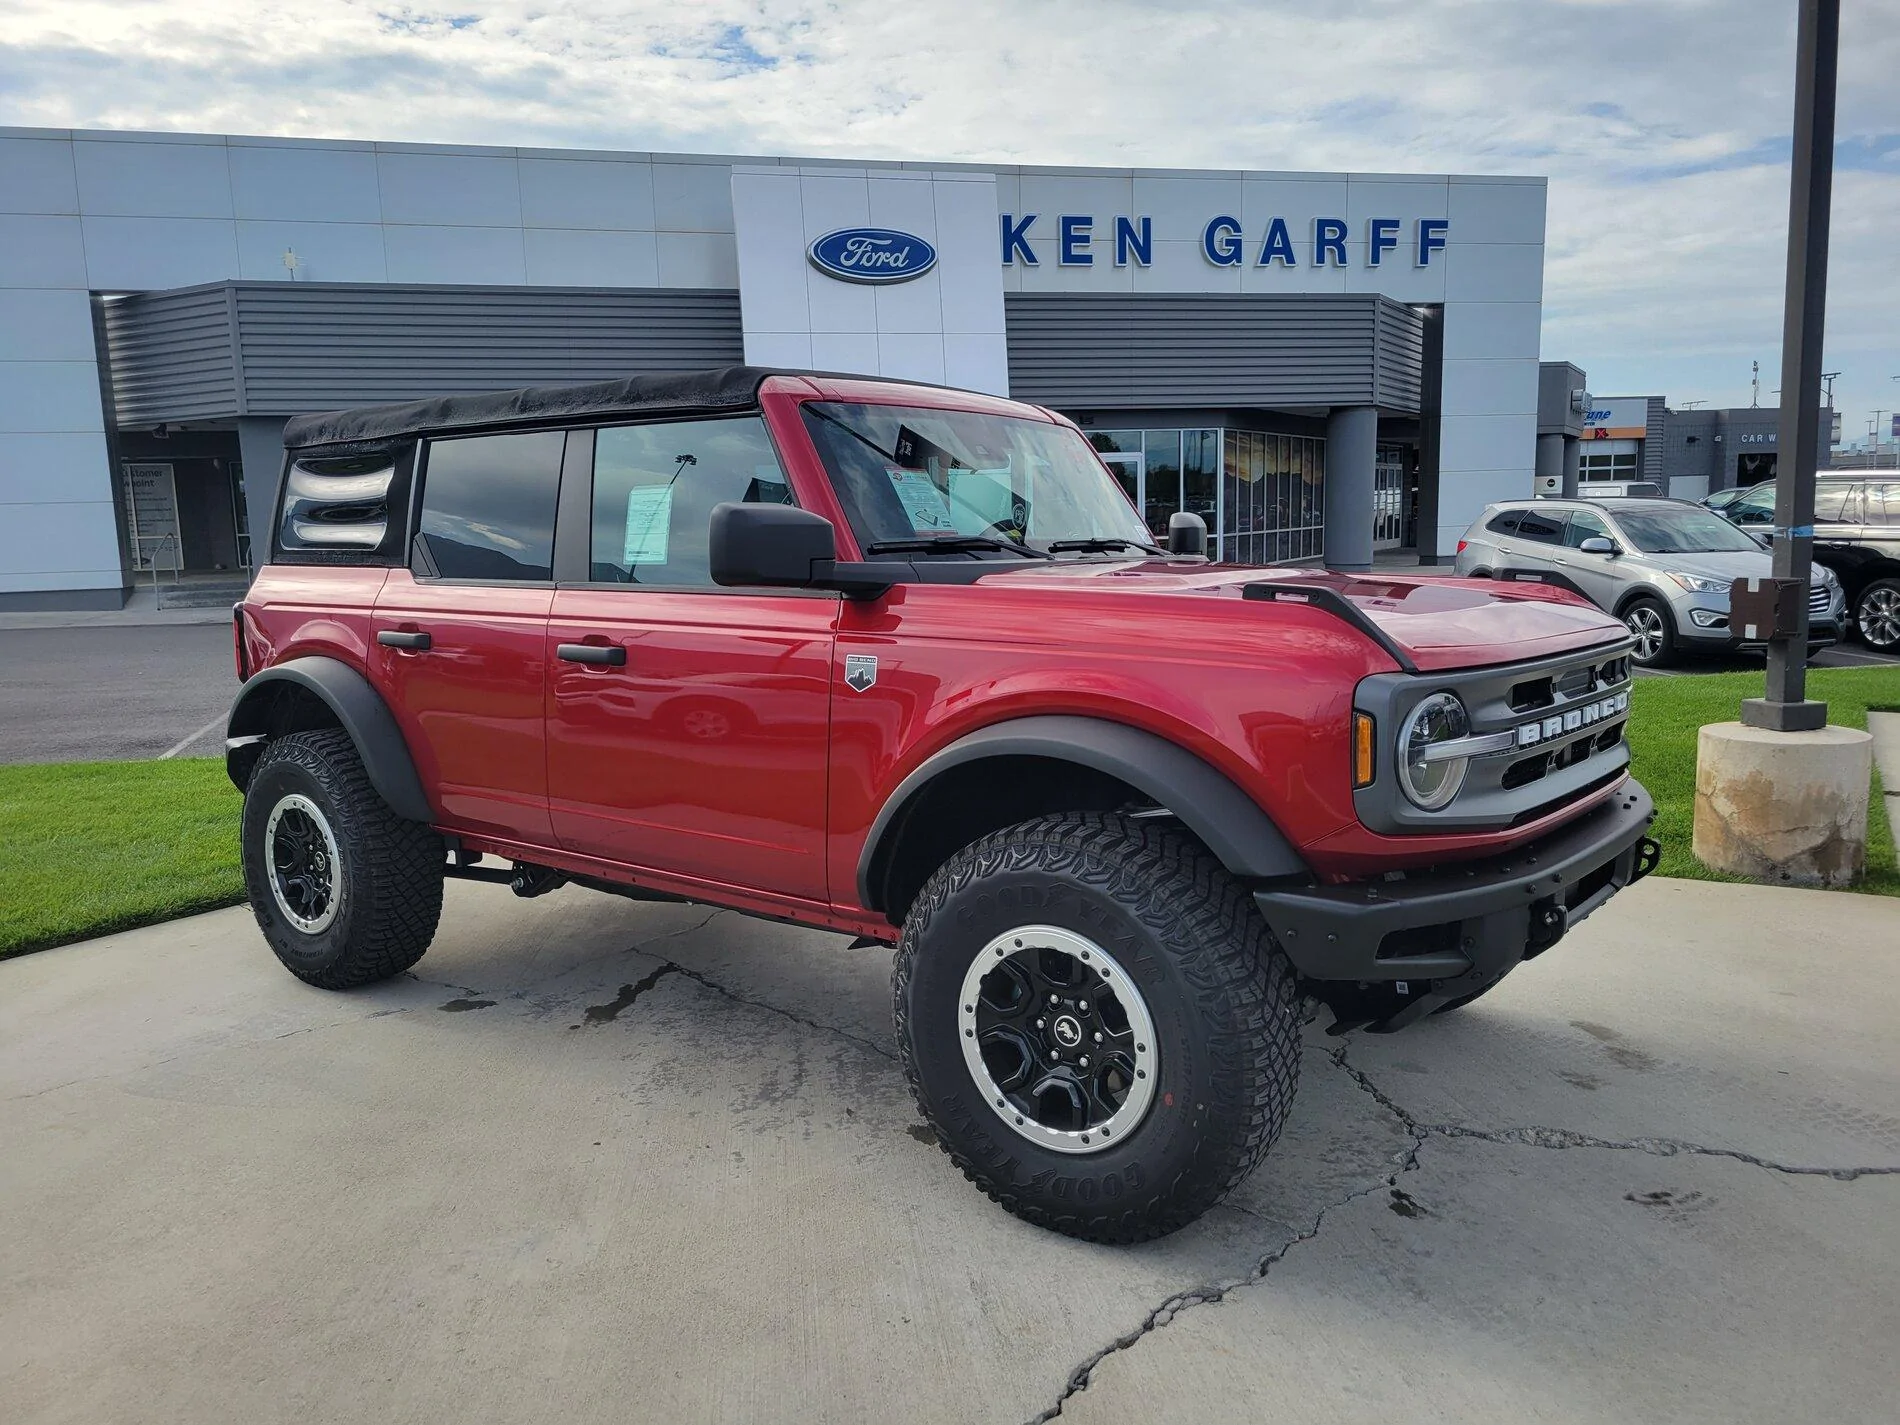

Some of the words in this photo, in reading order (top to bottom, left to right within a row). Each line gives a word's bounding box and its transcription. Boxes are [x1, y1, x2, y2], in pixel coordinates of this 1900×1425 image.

[1000, 213, 1153, 267] KEN
[1202, 214, 1450, 267] GARFF
[840, 237, 910, 268] Ford
[1584, 410, 1611, 421] ane
[1741, 434, 1763, 443] CAR
[121, 469, 163, 478] Cutomer
[1518, 691, 1628, 745] BRONCO
